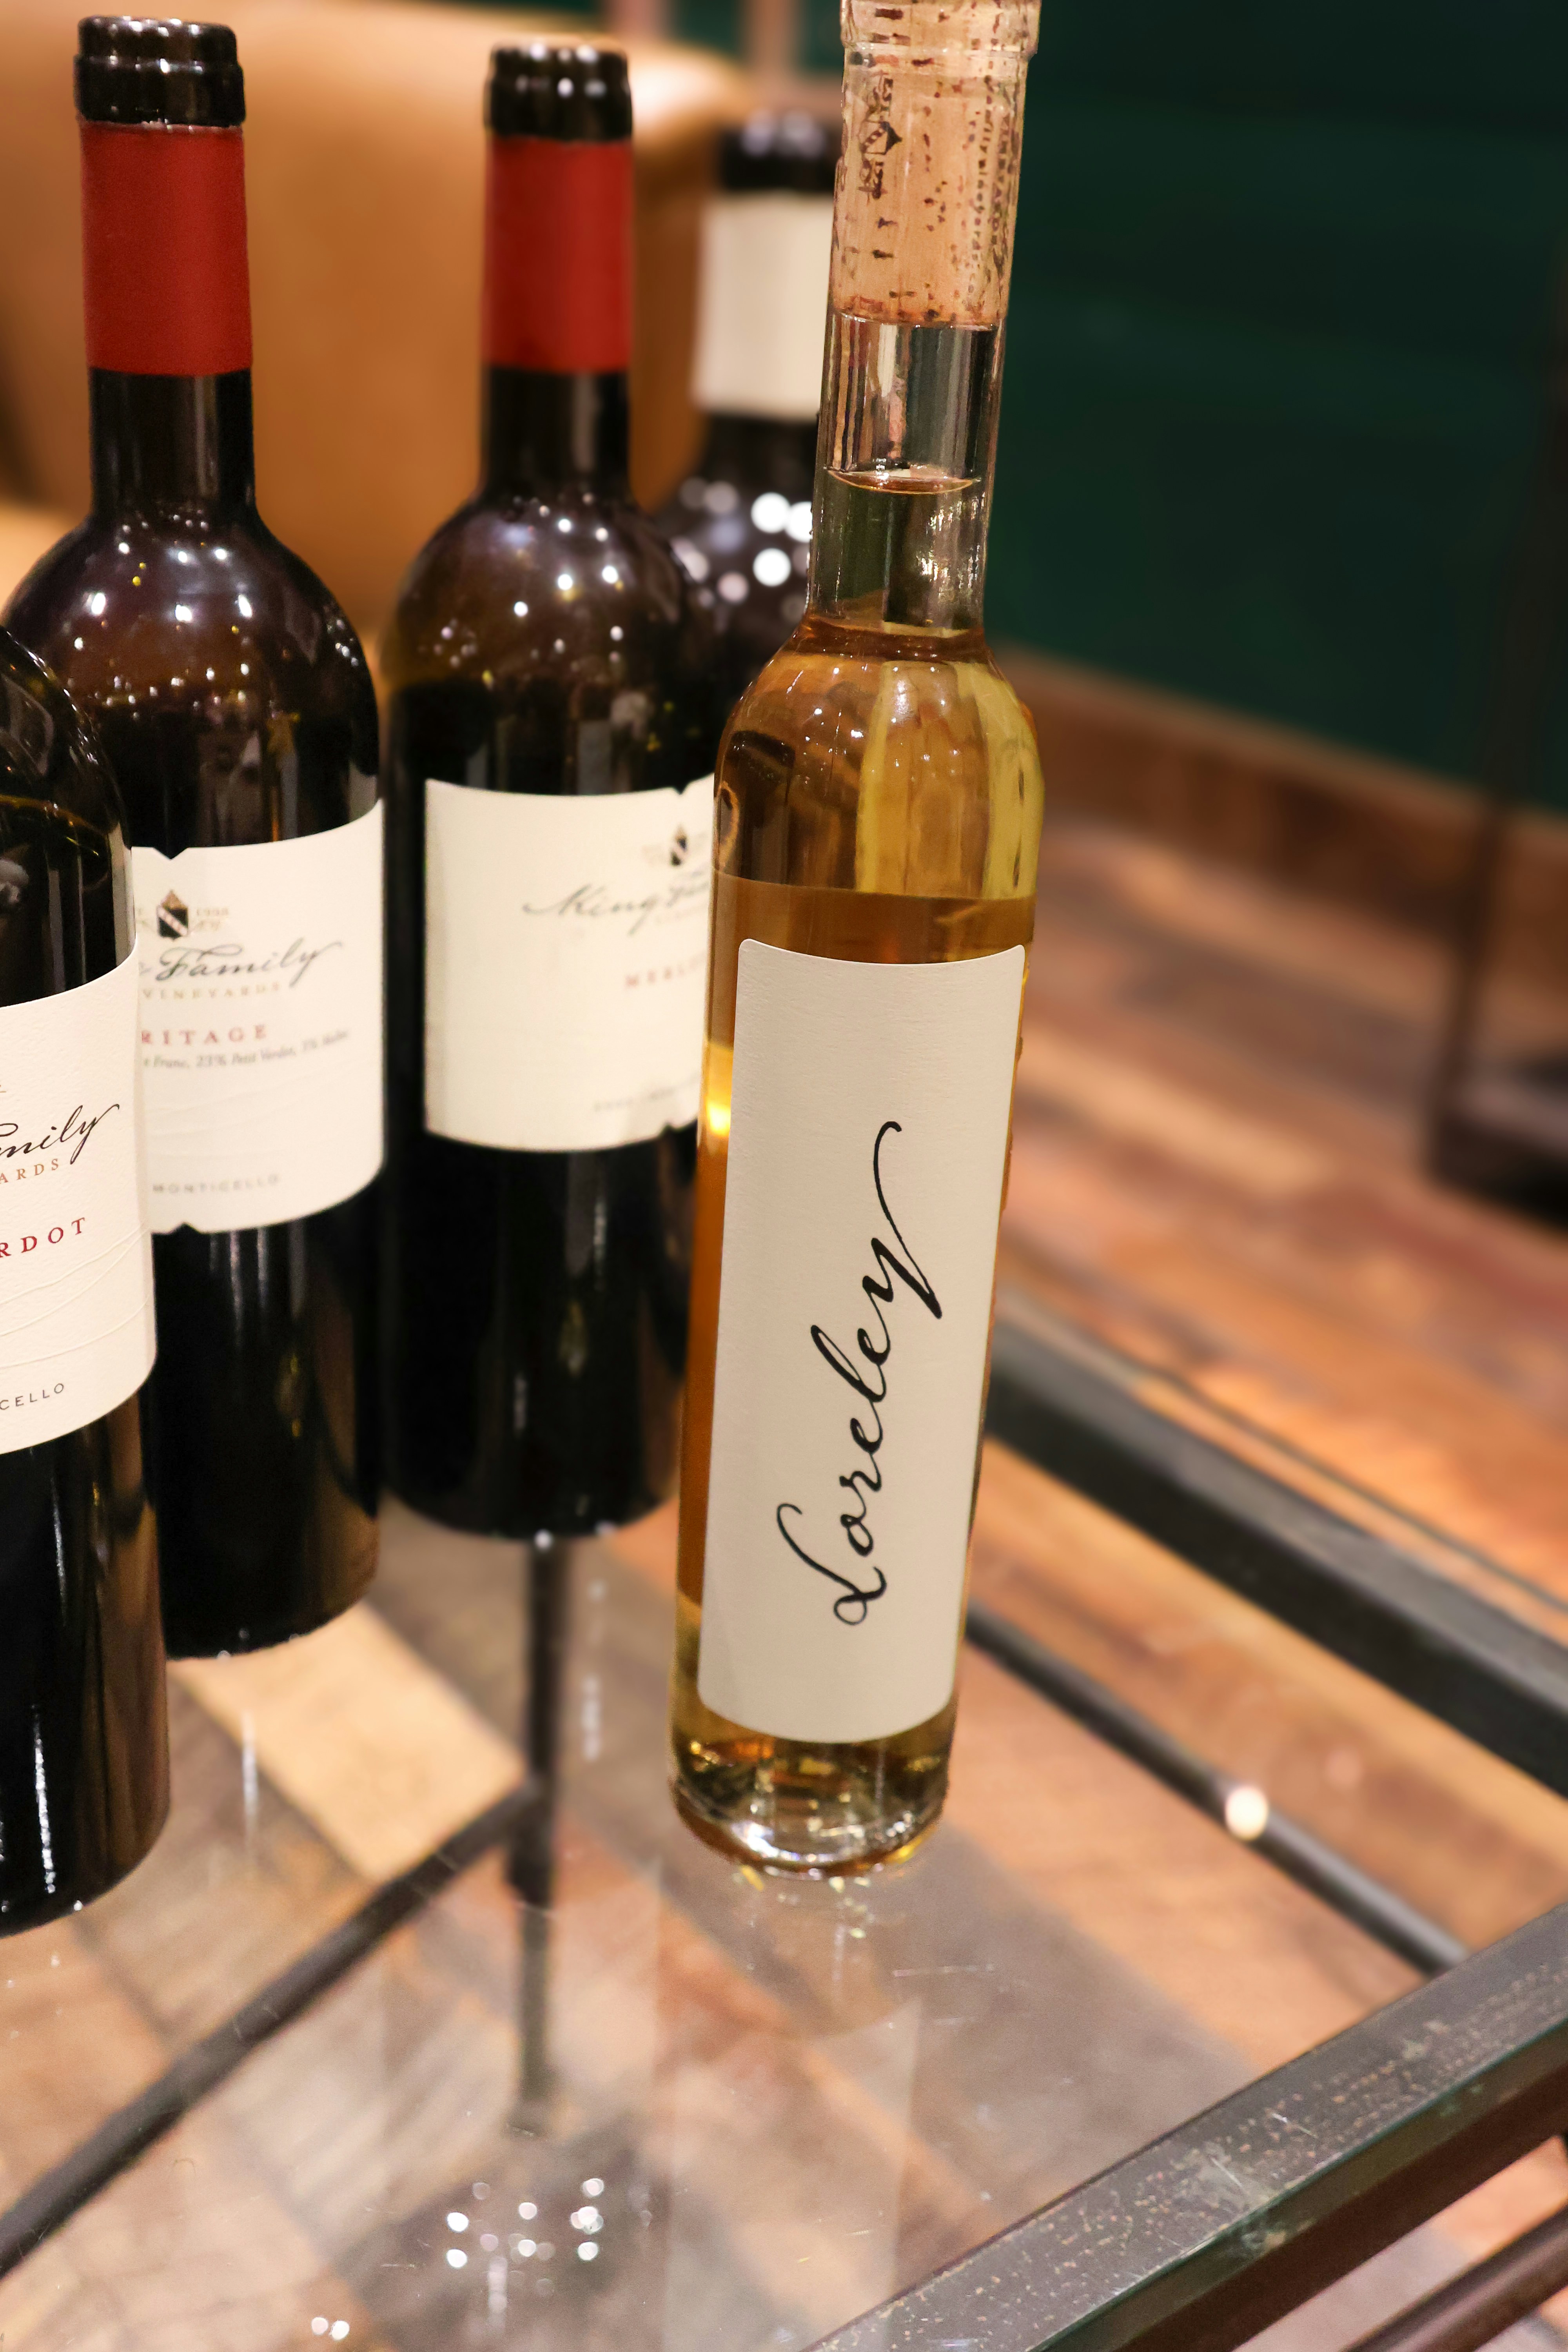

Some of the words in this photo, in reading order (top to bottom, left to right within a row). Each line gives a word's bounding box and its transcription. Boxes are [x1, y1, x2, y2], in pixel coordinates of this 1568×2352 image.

[156, 936, 343, 988] Family
[143, 982, 279, 1000] VINEYARDS
[0, 1158, 59, 1184] ARDS
[0, 1217, 85, 1258] RDOT
[777, 1121, 942, 1626] Loreley
[0, 1383, 64, 1410] CELLO
